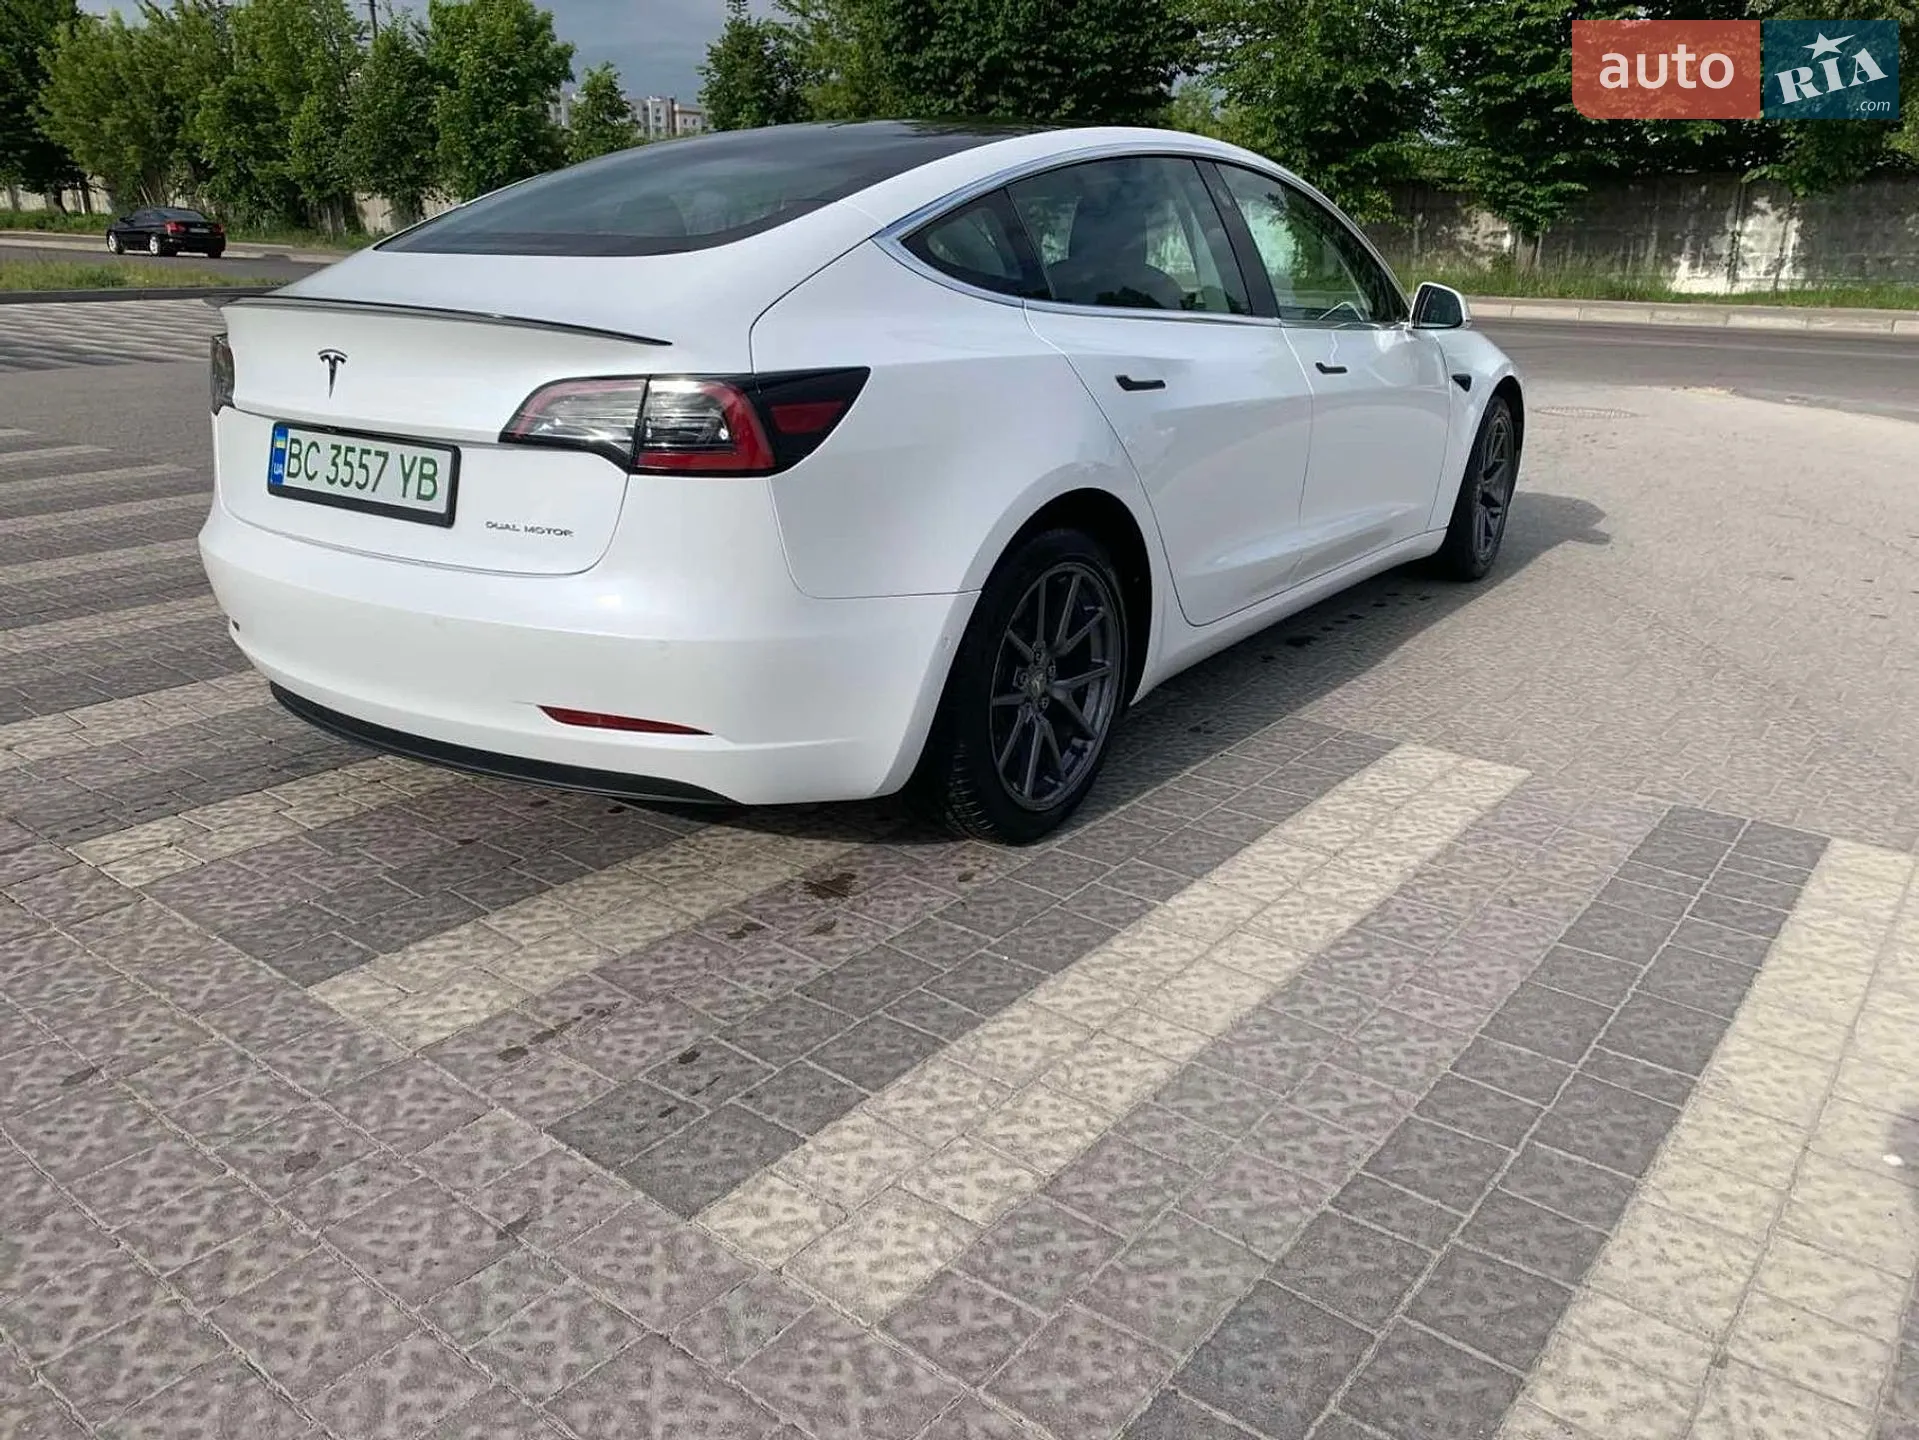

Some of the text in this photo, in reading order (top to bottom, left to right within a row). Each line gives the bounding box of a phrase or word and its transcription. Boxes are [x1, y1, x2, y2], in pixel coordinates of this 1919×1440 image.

[273, 463, 283, 475] UA
[286, 438, 438, 502] BC 3557 YB
[485, 521, 574, 537] DUAL MOTOR
